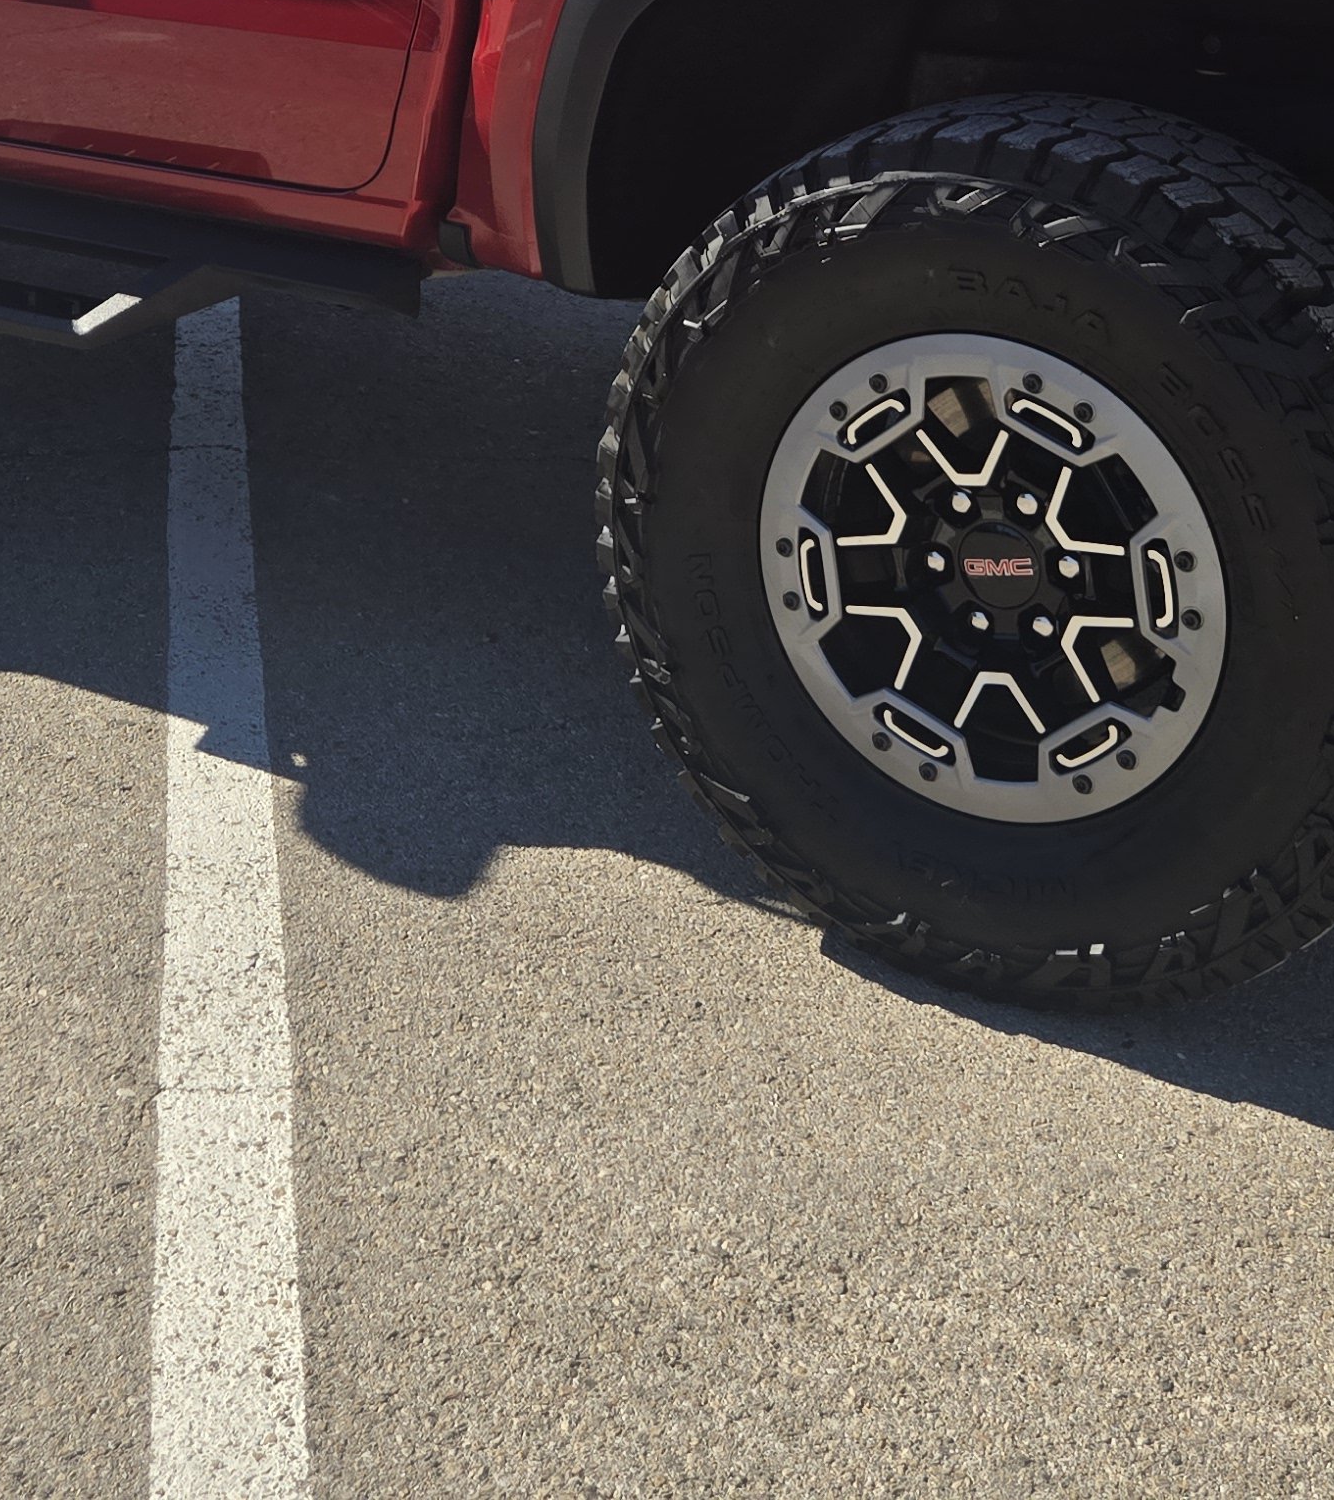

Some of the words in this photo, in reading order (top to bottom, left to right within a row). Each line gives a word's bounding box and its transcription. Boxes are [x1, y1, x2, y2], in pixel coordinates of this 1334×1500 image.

[948, 267, 1110, 346] BAJA
[1157, 361, 1273, 531] BOSS
[963, 557, 1034, 577] GMC
